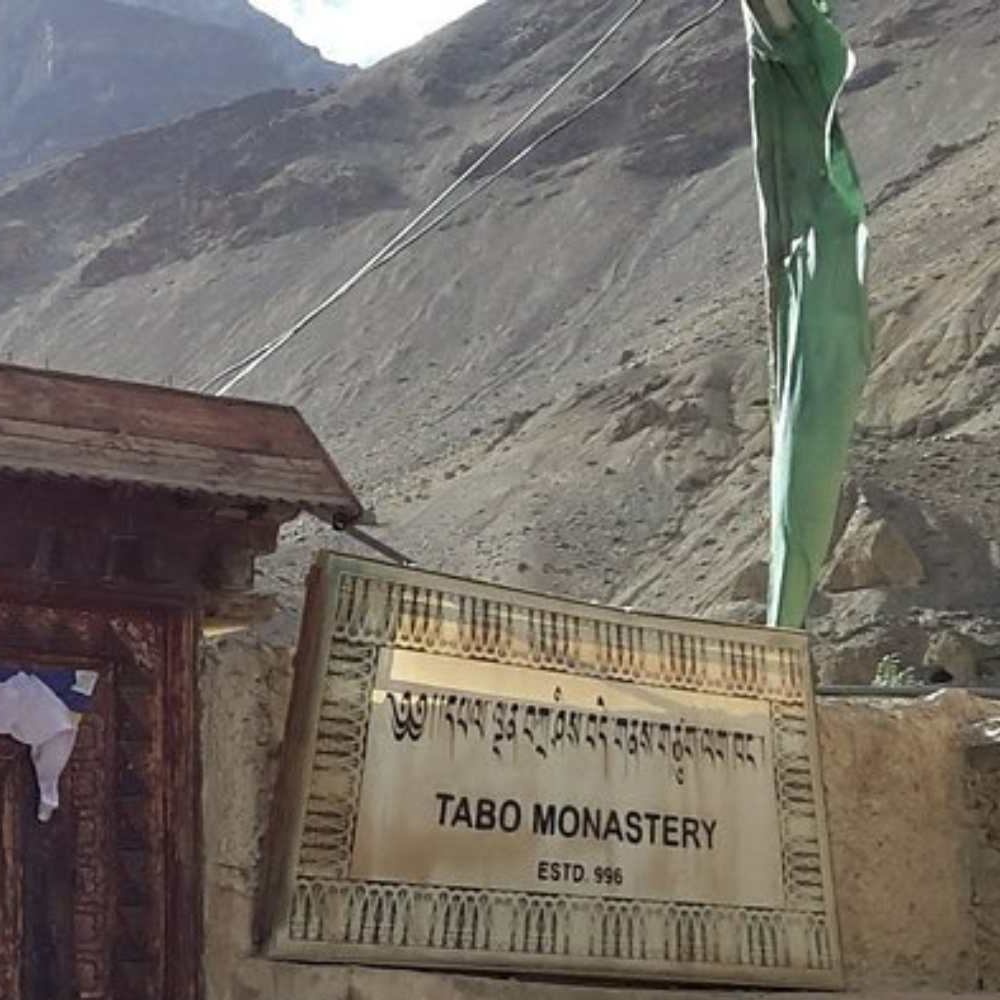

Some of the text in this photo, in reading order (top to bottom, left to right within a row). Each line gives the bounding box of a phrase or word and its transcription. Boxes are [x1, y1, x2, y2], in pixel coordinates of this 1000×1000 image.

[435, 792, 718, 850] TABO MONASTERY
[594, 866, 624, 885] 996
